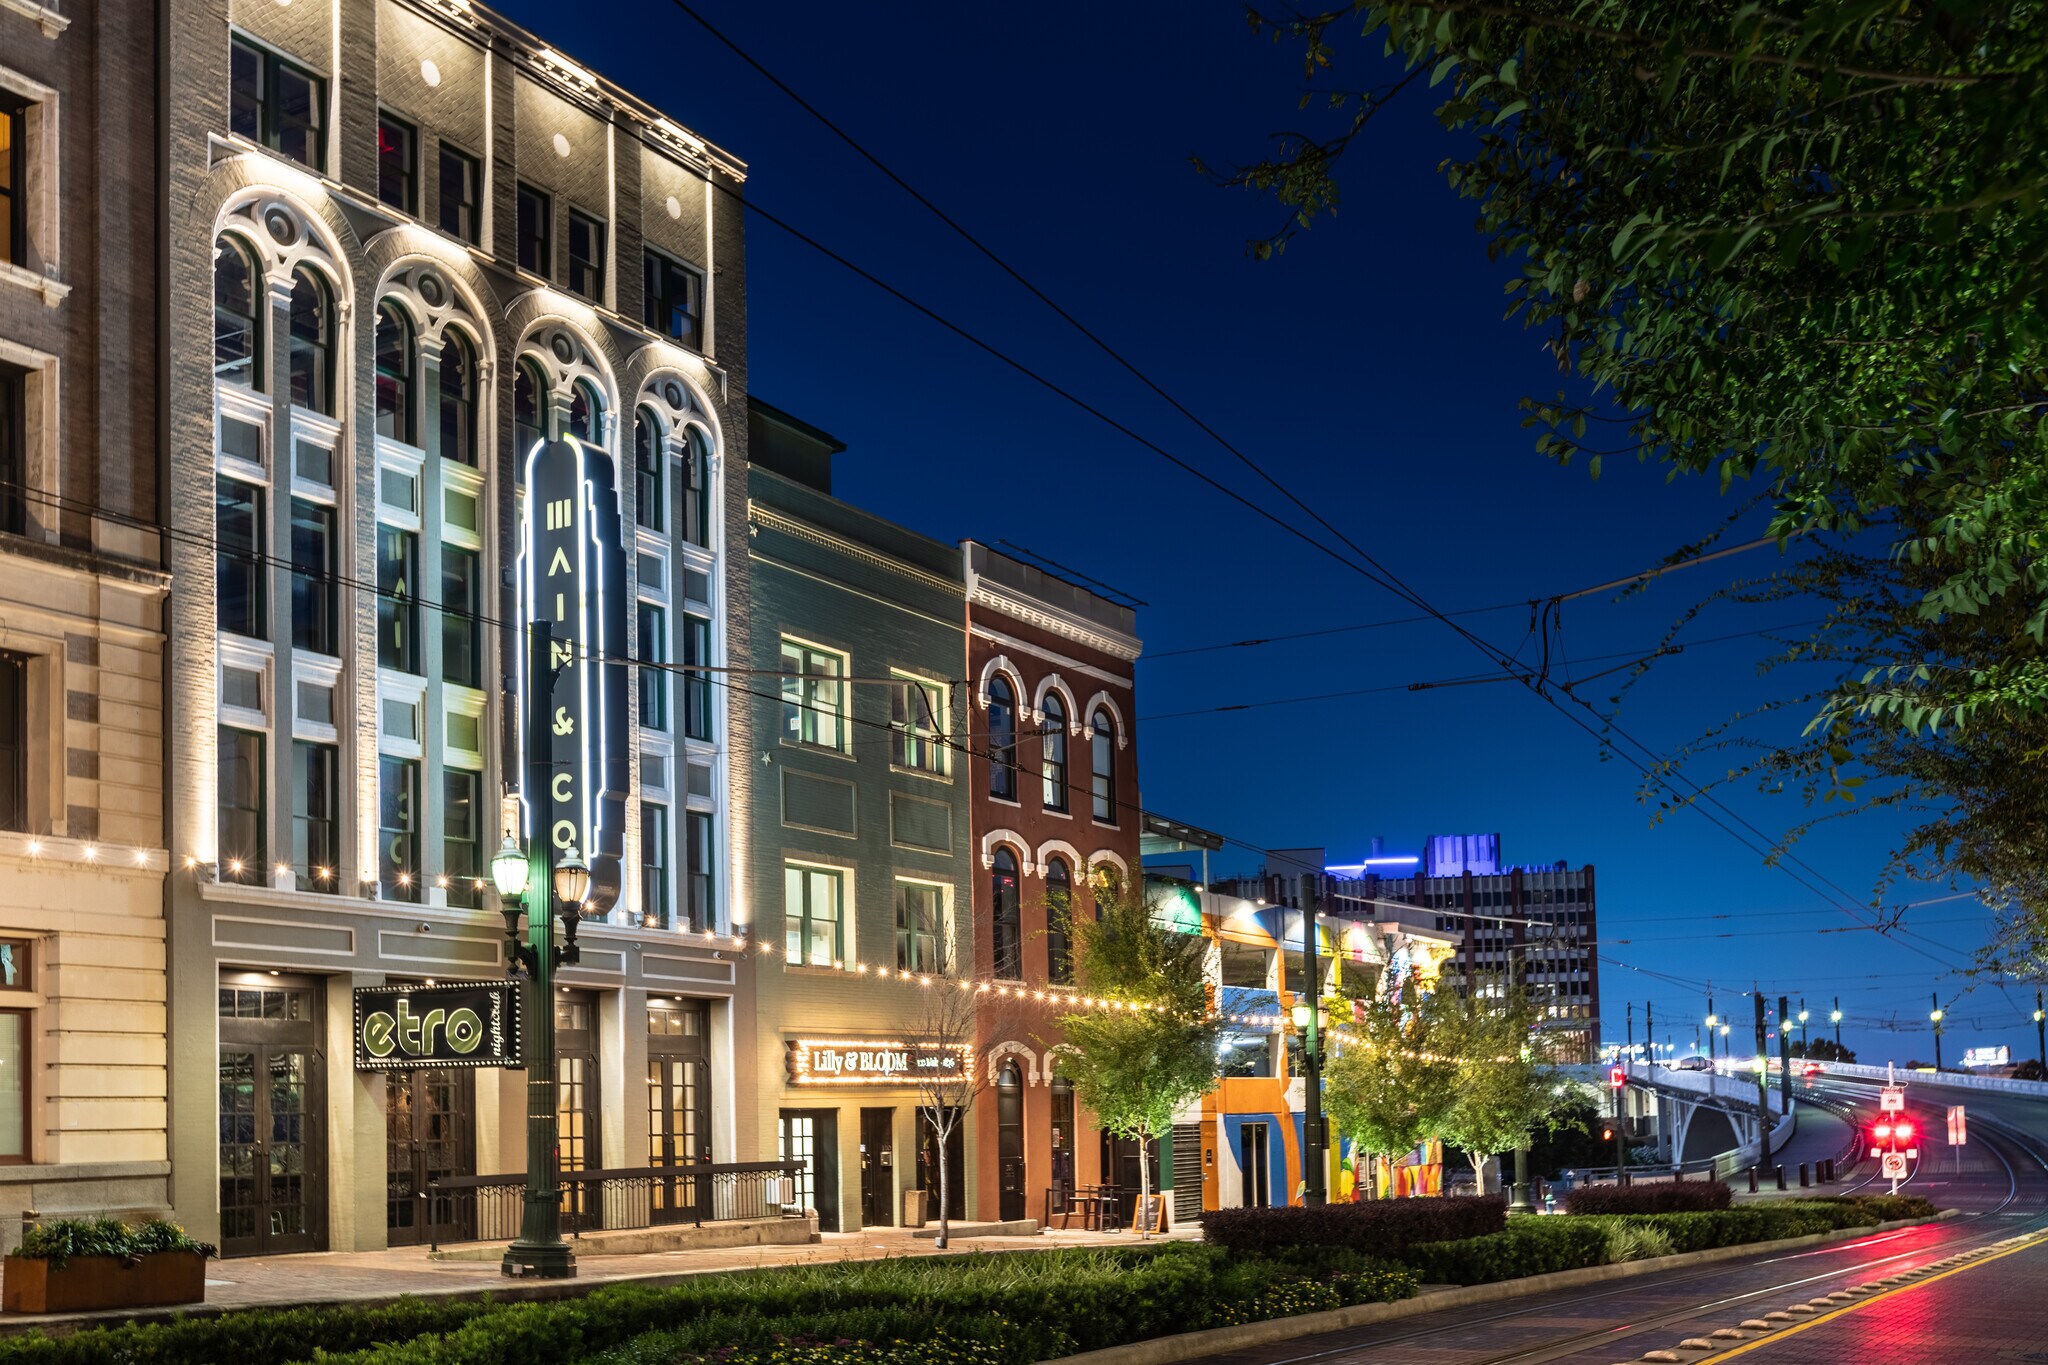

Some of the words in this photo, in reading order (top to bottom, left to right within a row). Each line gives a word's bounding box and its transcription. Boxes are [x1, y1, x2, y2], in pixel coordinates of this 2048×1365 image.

[363, 999, 483, 1057] etro
[489, 991, 505, 1057] nightclub
[813, 1050, 844, 1075] Lilly
[845, 1052, 858, 1071] &
[860, 1049, 908, 1076] BLOOM
